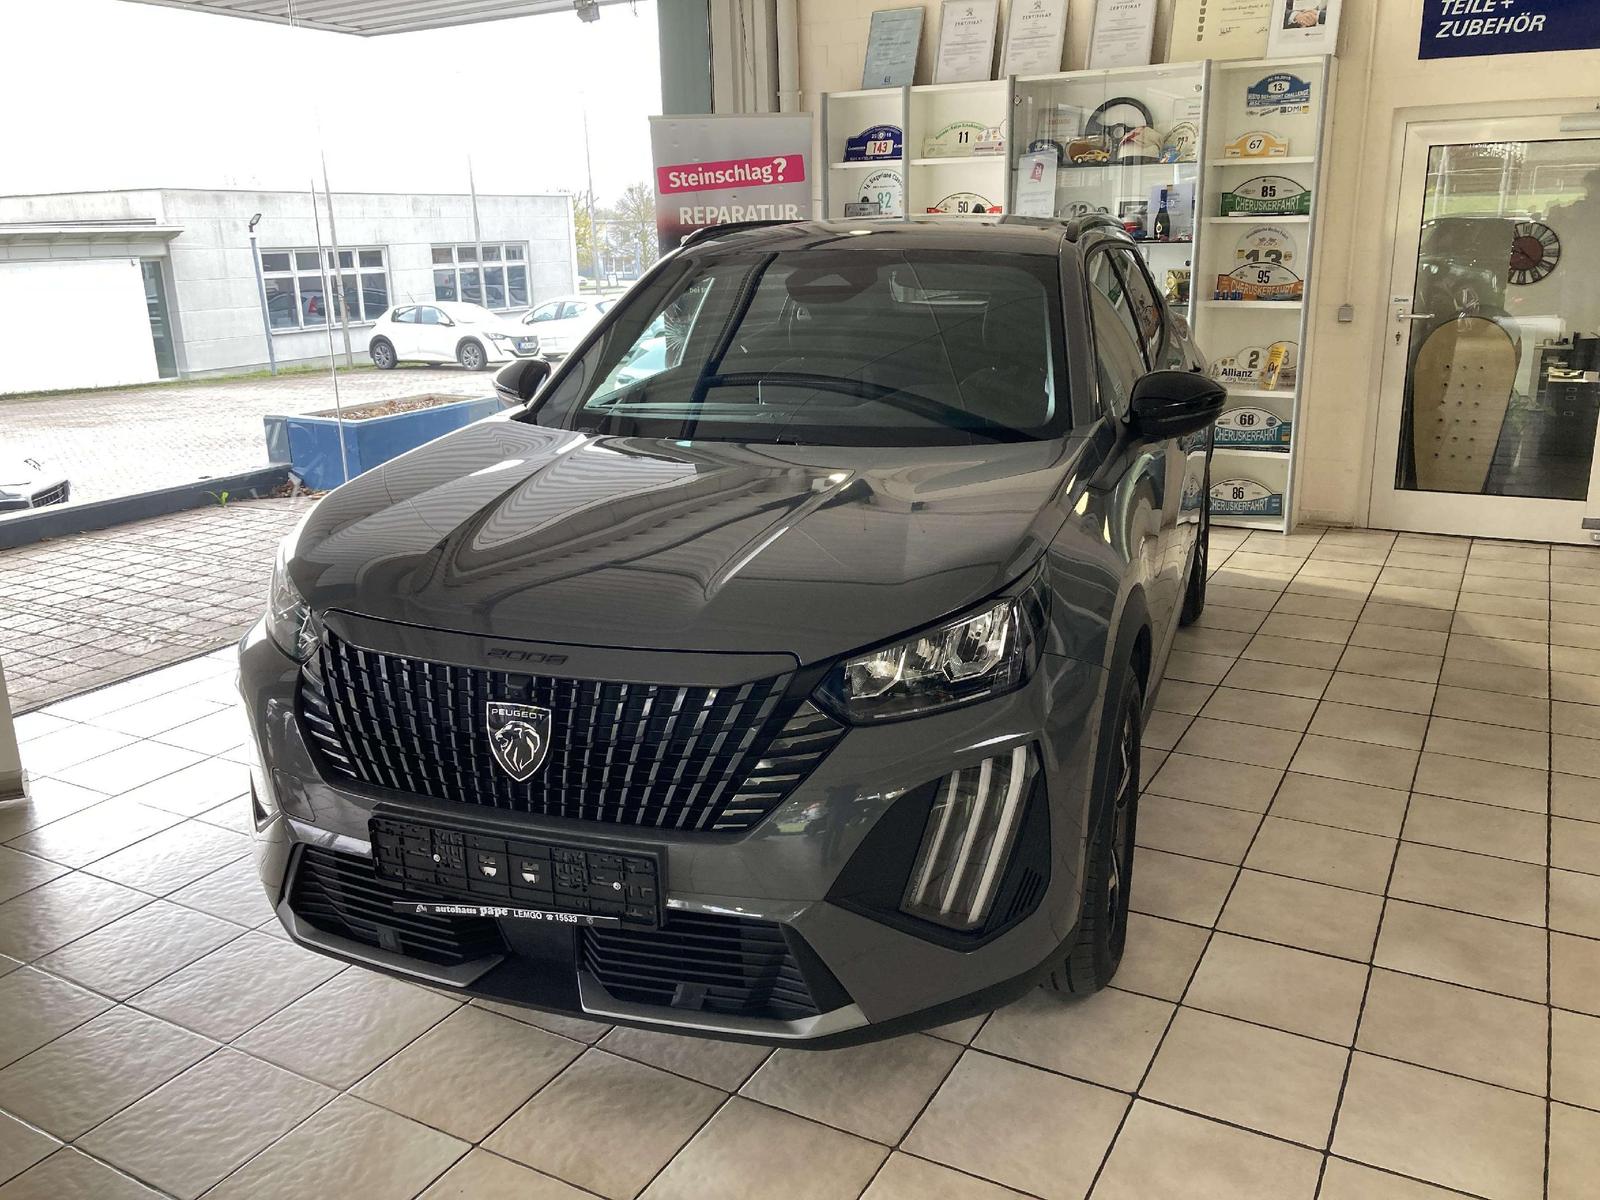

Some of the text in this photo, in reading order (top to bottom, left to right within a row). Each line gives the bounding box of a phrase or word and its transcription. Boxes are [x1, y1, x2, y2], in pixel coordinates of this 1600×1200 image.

[1435, 12, 1547, 39] ZUBEHÖR
[959, 131, 969, 144] 11
[873, 142, 888, 154] 143
[1249, 139, 1263, 150] 67
[668, 157, 788, 188] Steinschlag?
[1261, 185, 1277, 198] 85
[957, 201, 970, 214] 50
[1235, 196, 1301, 212] CHERUSKERFAHRT
[679, 204, 804, 226] REPARATUR.
[1257, 270, 1271, 284] 95
[1221, 368, 1253, 377] Allianz
[1239, 414, 1255, 426] 68
[1214, 427, 1279, 441] CHERUSKERFAHRT
[1232, 487, 1245, 500] 86
[488, 647, 569, 666] 2008
[491, 708, 545, 720] PEUGEOT
[435, 904, 578, 923] autohaus pape LEMGO 15533
